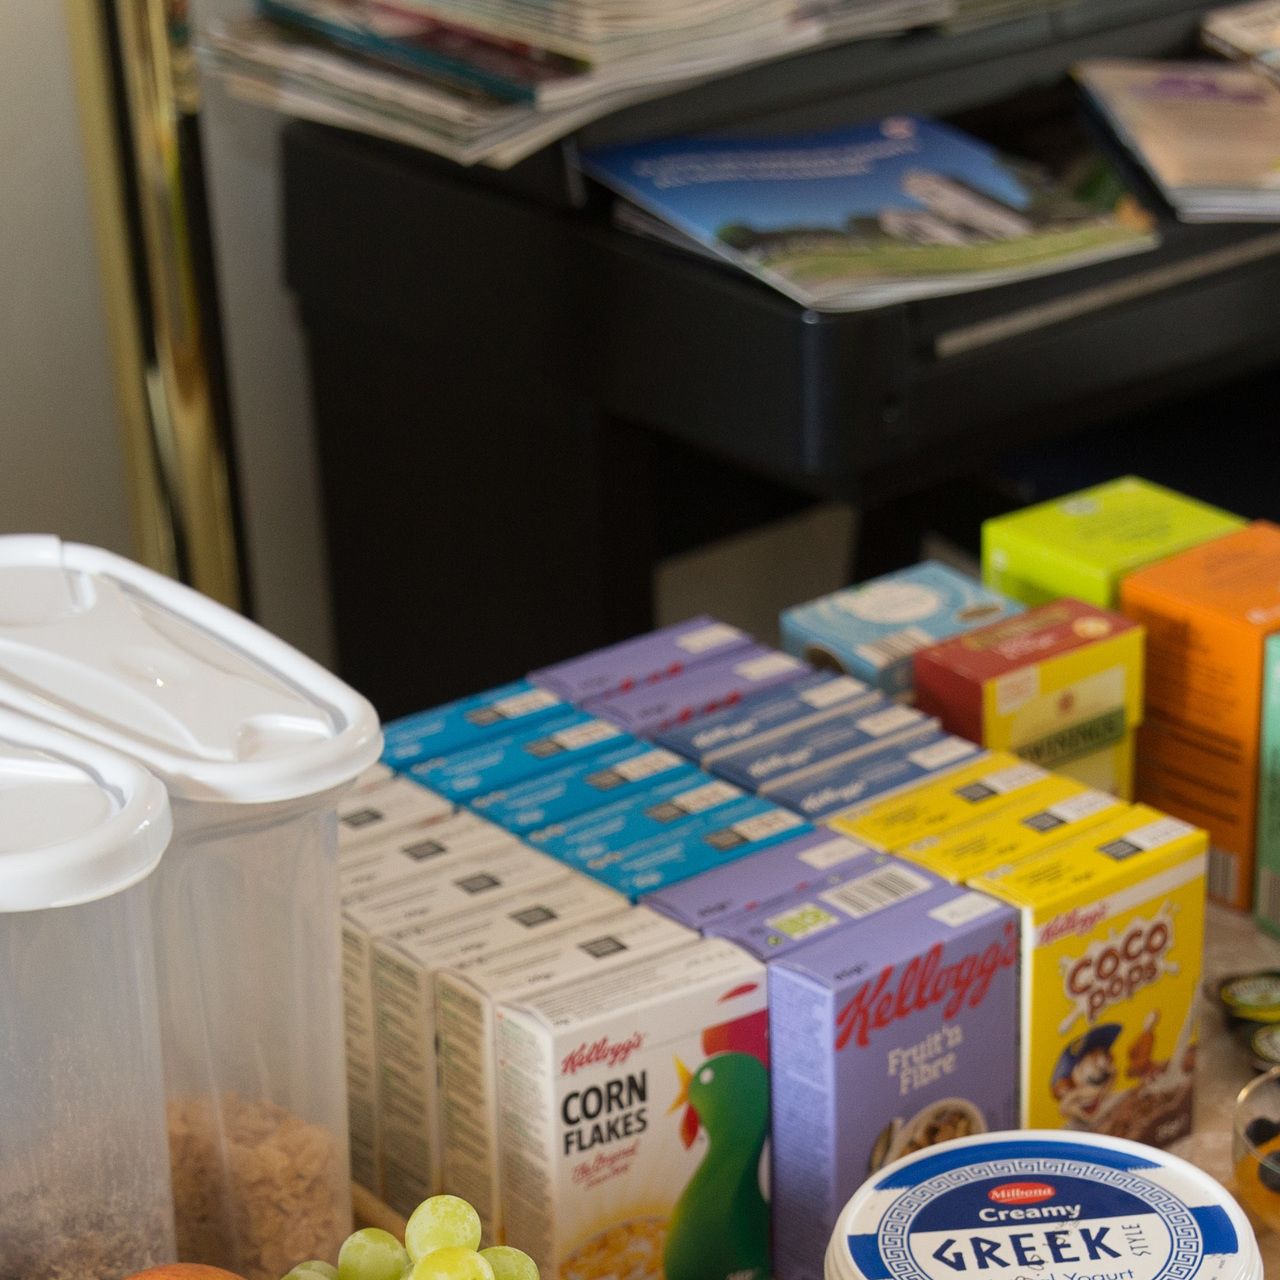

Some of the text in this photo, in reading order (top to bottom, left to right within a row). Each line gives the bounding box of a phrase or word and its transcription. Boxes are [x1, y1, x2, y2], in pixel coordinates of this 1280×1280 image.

[835, 921, 1018, 1052] Kellogg's
[561, 1031, 645, 1075] Kellogg's
[900, 1052, 956, 1096] Fibre
[562, 1069, 647, 1126] CORN
[563, 1108, 648, 1156] FLAKES
[978, 1202, 1082, 1223] Creamy
[991, 1185, 1054, 1202] Milbona
[932, 1226, 1122, 1272] GREEK
[1121, 1223, 1151, 1257] STYLE
